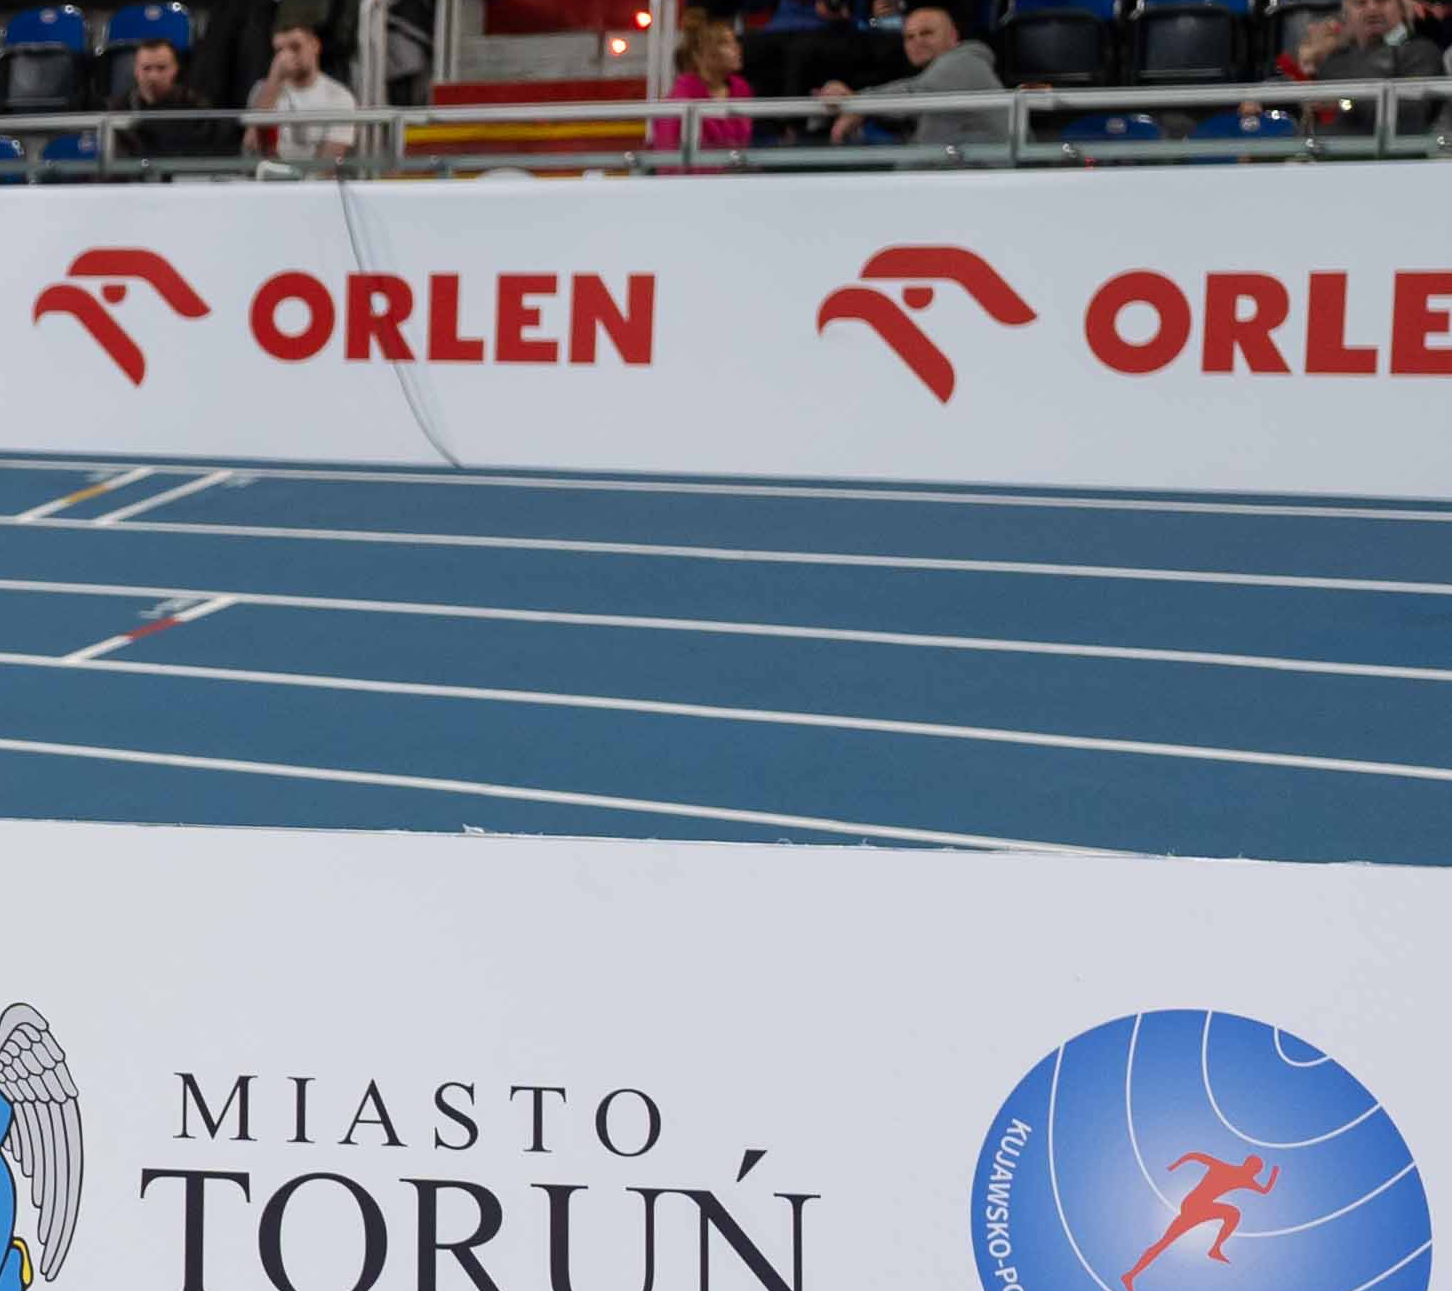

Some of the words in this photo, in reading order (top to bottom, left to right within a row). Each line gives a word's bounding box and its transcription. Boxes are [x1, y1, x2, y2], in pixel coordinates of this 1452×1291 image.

[249, 270, 657, 366] ORLEN
[1083, 269, 1452, 378] ORLE
[173, 1071, 663, 1158] MIASTO
